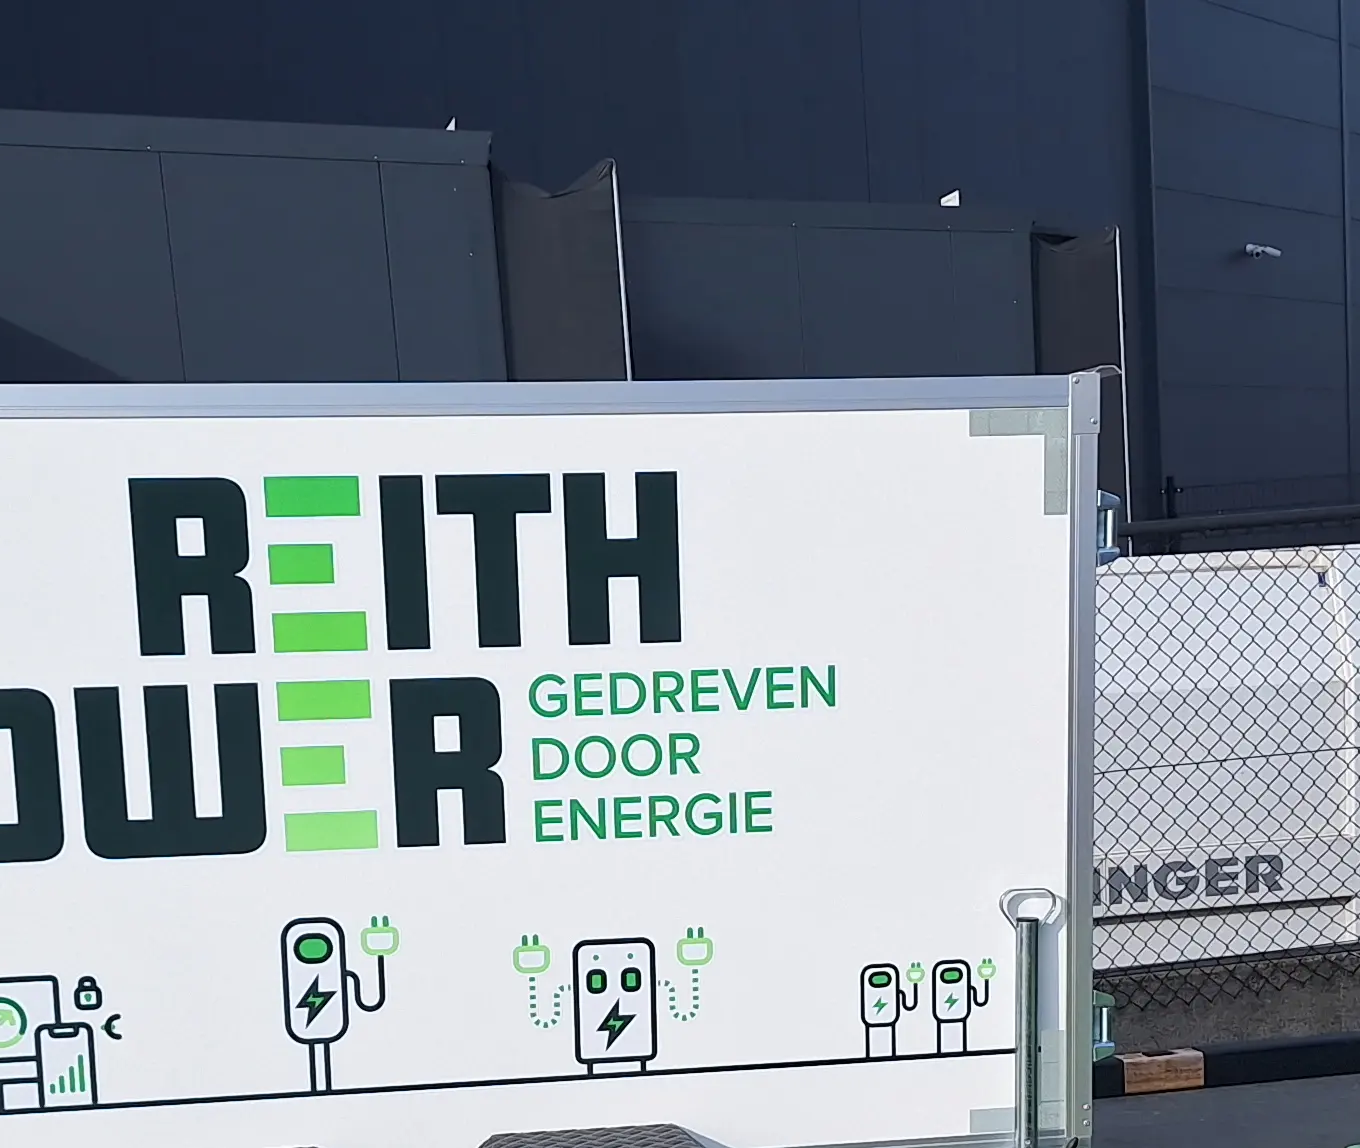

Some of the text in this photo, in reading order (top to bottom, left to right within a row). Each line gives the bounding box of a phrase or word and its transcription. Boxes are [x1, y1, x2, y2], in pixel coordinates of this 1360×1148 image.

[128, 470, 682, 657] REITH
[528, 664, 837, 720] GEDREVEN
[531, 732, 702, 781] DOOR
[534, 790, 774, 843] ENERGIE
